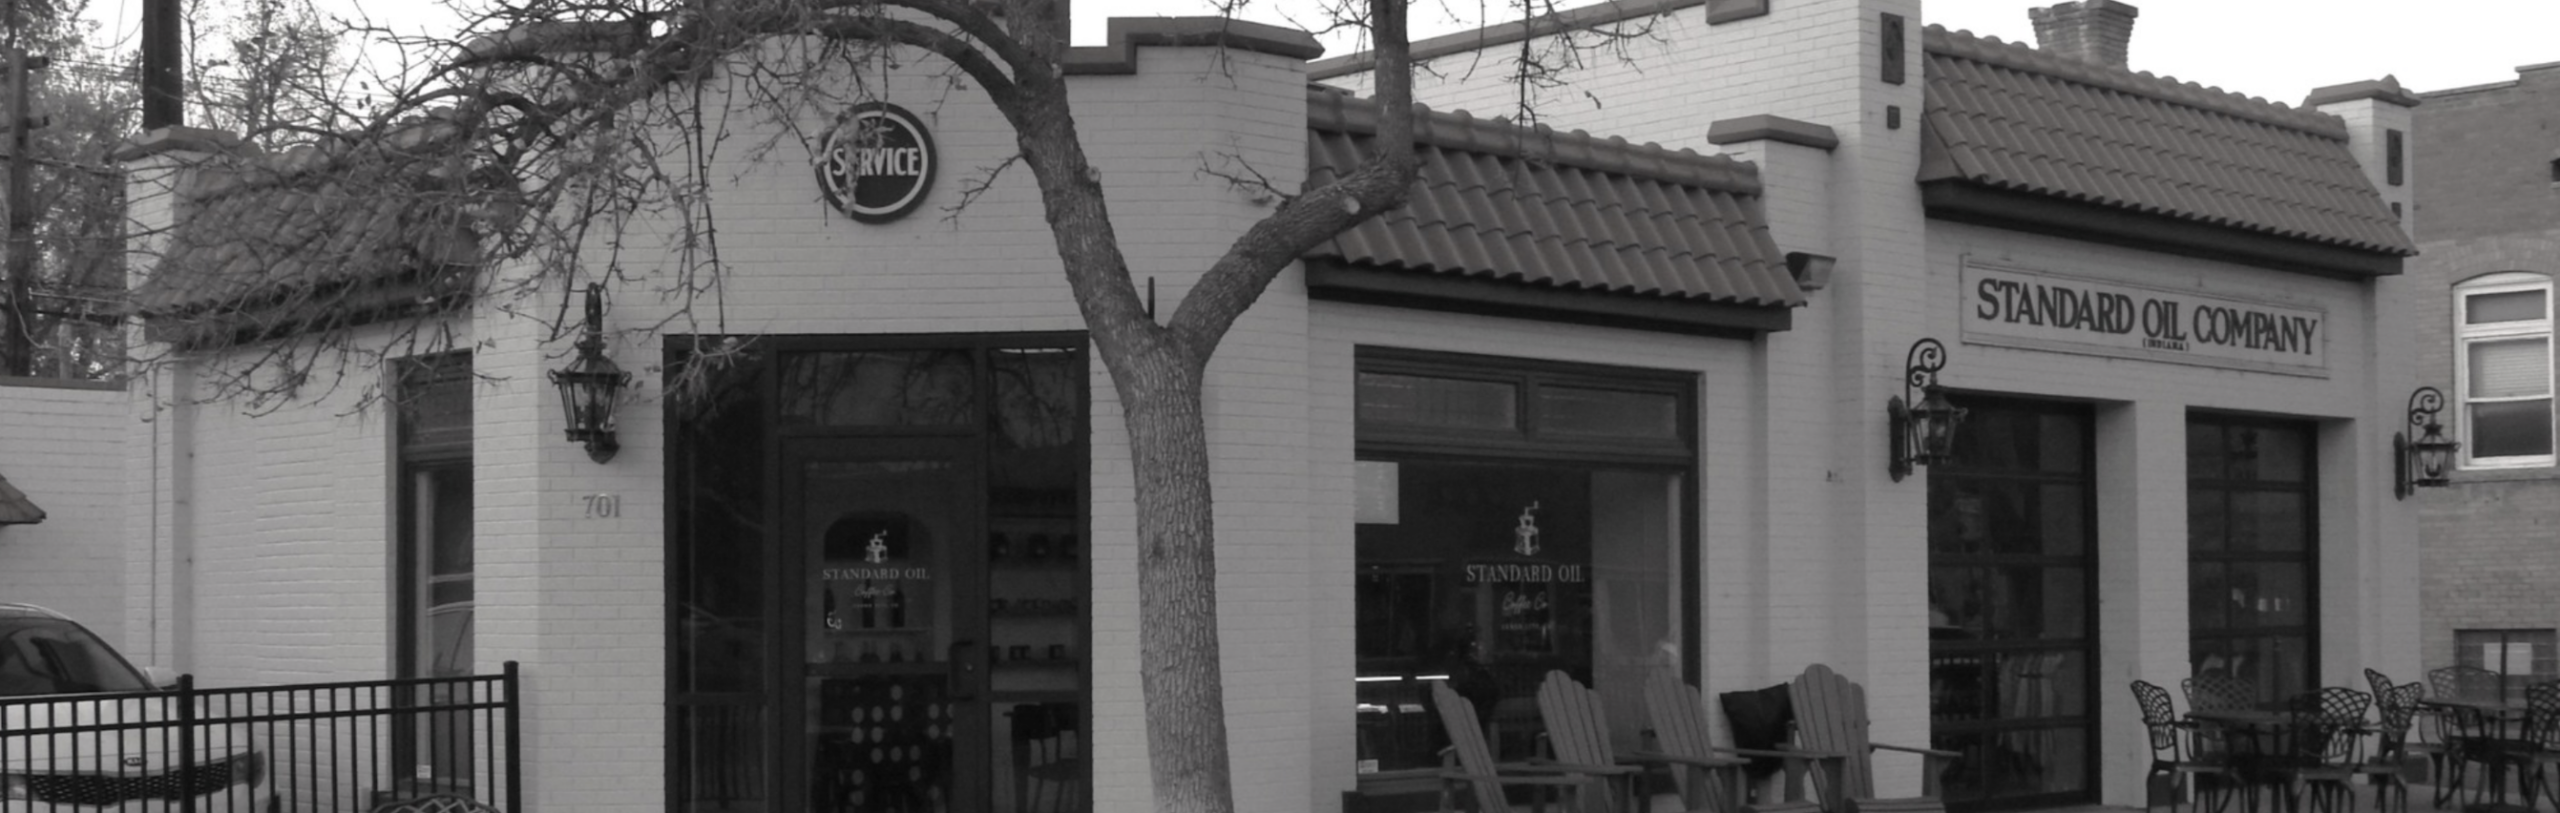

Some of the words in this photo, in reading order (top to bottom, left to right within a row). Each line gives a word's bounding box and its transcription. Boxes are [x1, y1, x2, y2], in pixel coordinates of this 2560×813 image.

[833, 148, 918, 176] SRVICE
[1977, 278, 2135, 334] STANDARD
[2142, 298, 2187, 341] OIL
[2193, 305, 2317, 355] COMPANY
[582, 493, 621, 518] 701
[823, 569, 899, 580] STANDARD
[905, 568, 930, 580] OIL
[1466, 565, 1552, 583] STANDARD
[1558, 565, 1585, 583] OIL
[1502, 591, 1531, 614] Coffee
